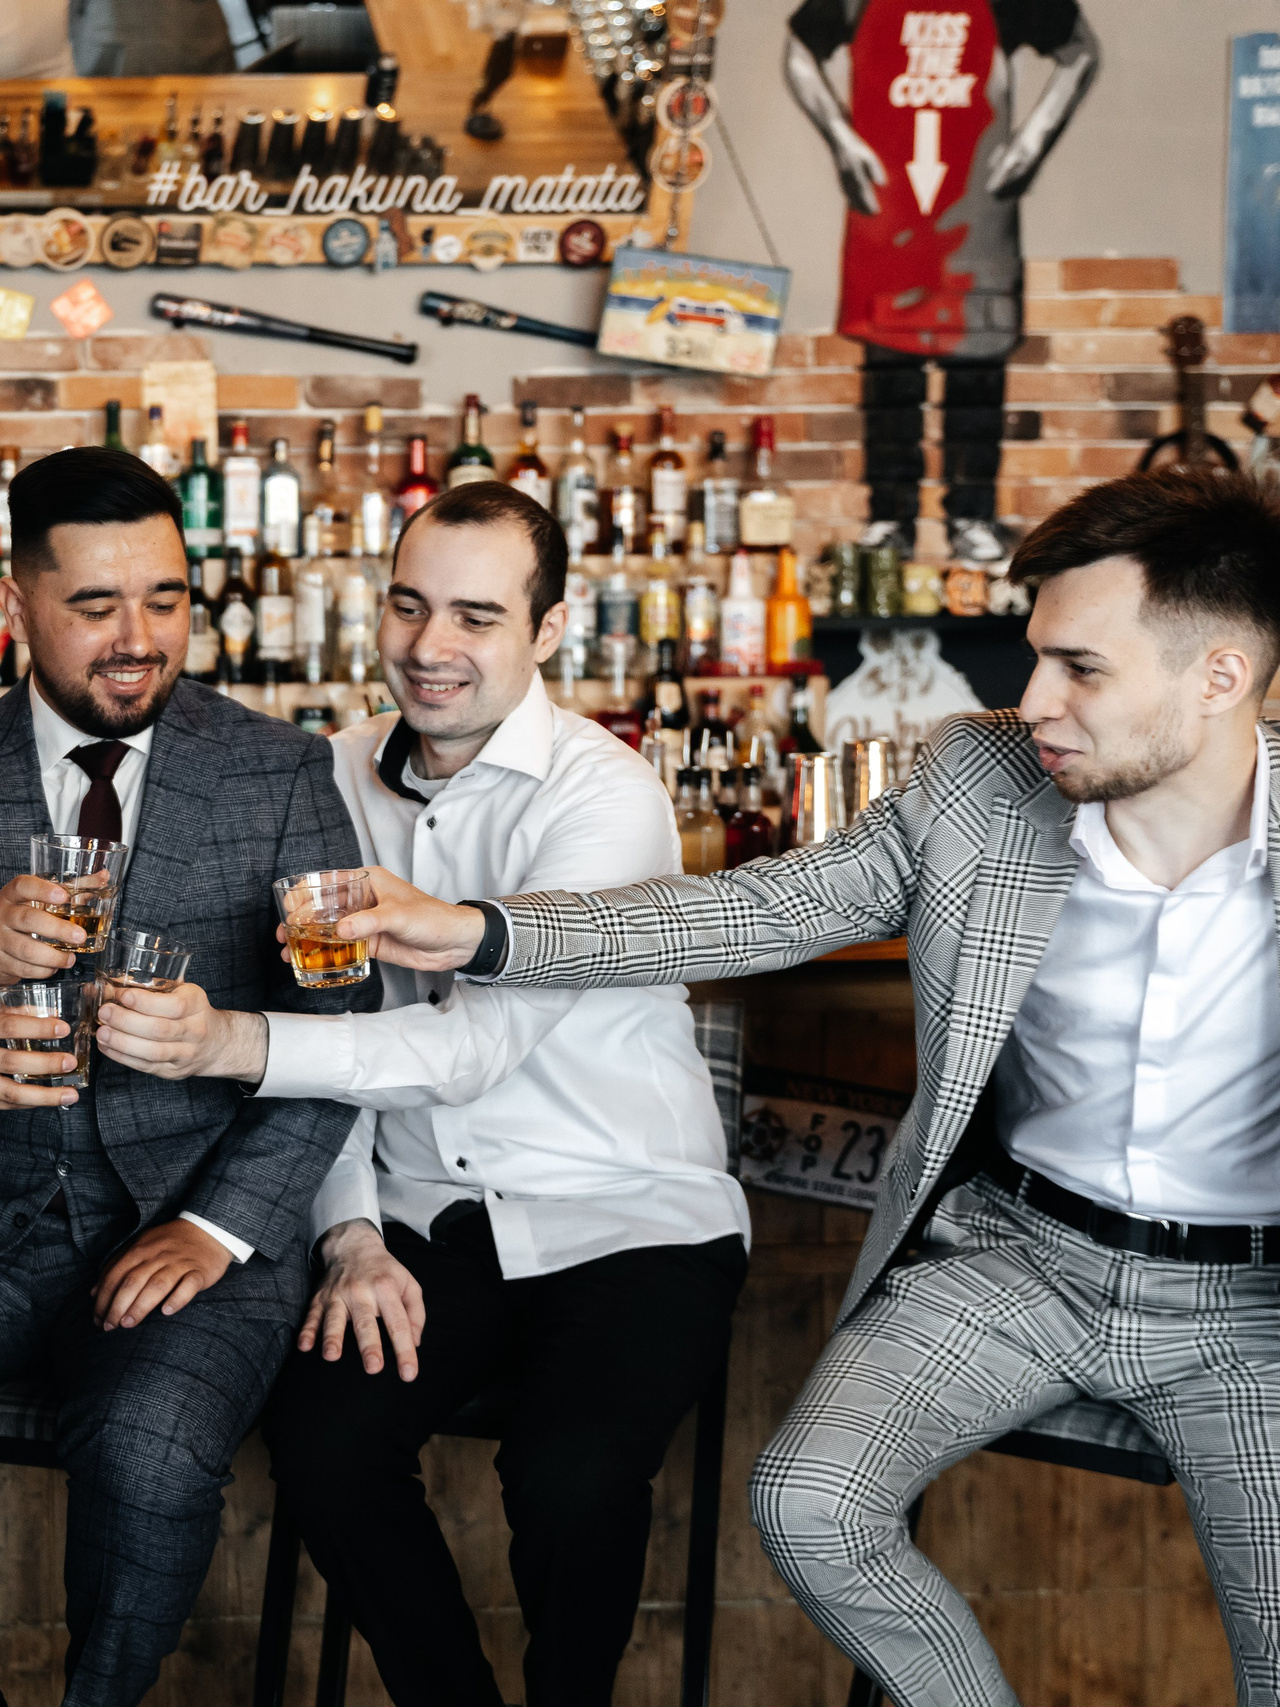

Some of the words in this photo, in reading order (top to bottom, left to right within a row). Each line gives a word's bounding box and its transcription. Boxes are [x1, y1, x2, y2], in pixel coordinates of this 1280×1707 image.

[900, 10, 971, 47] KISS
[906, 46, 965, 76] THE
[888, 72, 979, 108] COOK
